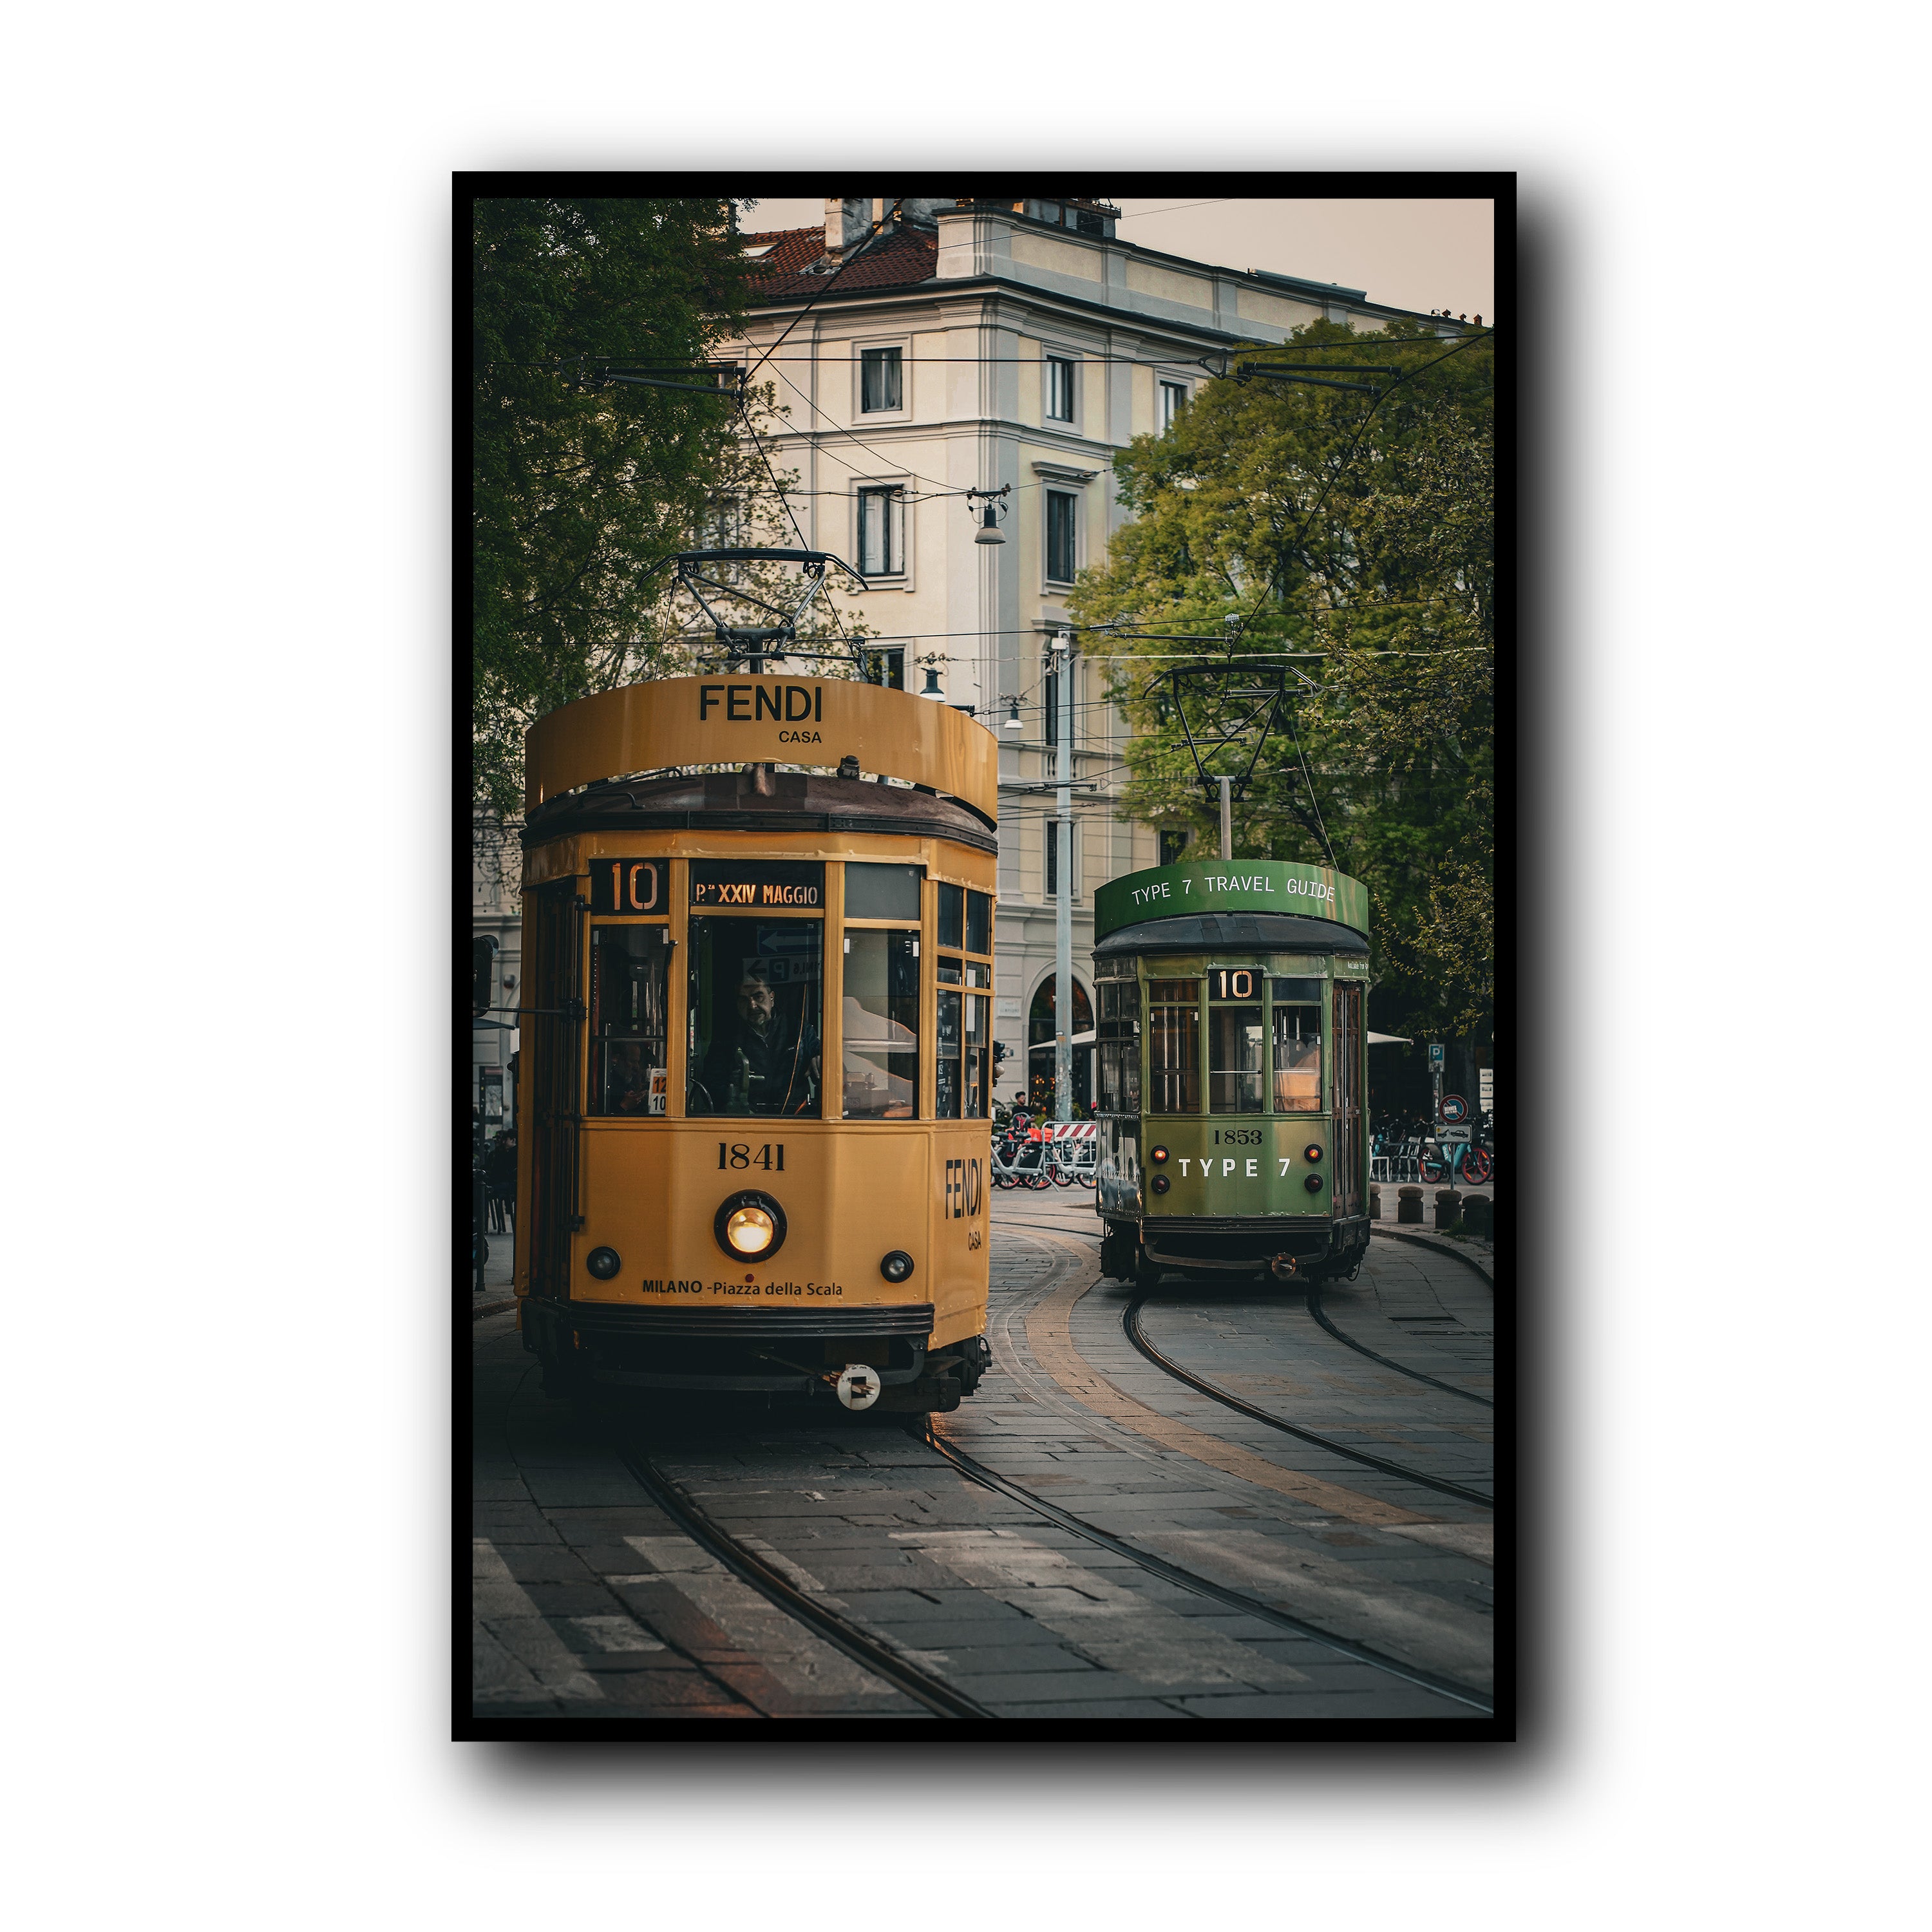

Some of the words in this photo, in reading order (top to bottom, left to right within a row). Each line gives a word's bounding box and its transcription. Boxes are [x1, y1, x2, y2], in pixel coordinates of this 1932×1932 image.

[699, 685, 822, 723] FENDI
[779, 730, 822, 744] CASA
[612, 862, 658, 910] 10
[718, 884, 757, 903] XXIV
[762, 885, 818, 905] MAGGIO
[1132, 882, 1171, 905] TYPE
[1182, 879, 1191, 895] 7
[1204, 876, 1274, 892] TRAVEL
[1287, 878, 1336, 903] GUIDE
[1219, 971, 1253, 998] 10
[654, 1077, 667, 1093] 12
[653, 1095, 666, 1111] 10
[1214, 1130, 1263, 1145] 1853
[717, 1142, 785, 1171] 1841
[1179, 1159, 1258, 1177] TYPE
[1278, 1158, 1291, 1177] 7
[945, 1158, 982, 1220] FENDI
[968, 1231, 981, 1251] CASA
[643, 1280, 703, 1294] MILANO
[764, 1282, 802, 1296] della
[806, 1282, 842, 1296] Scala
